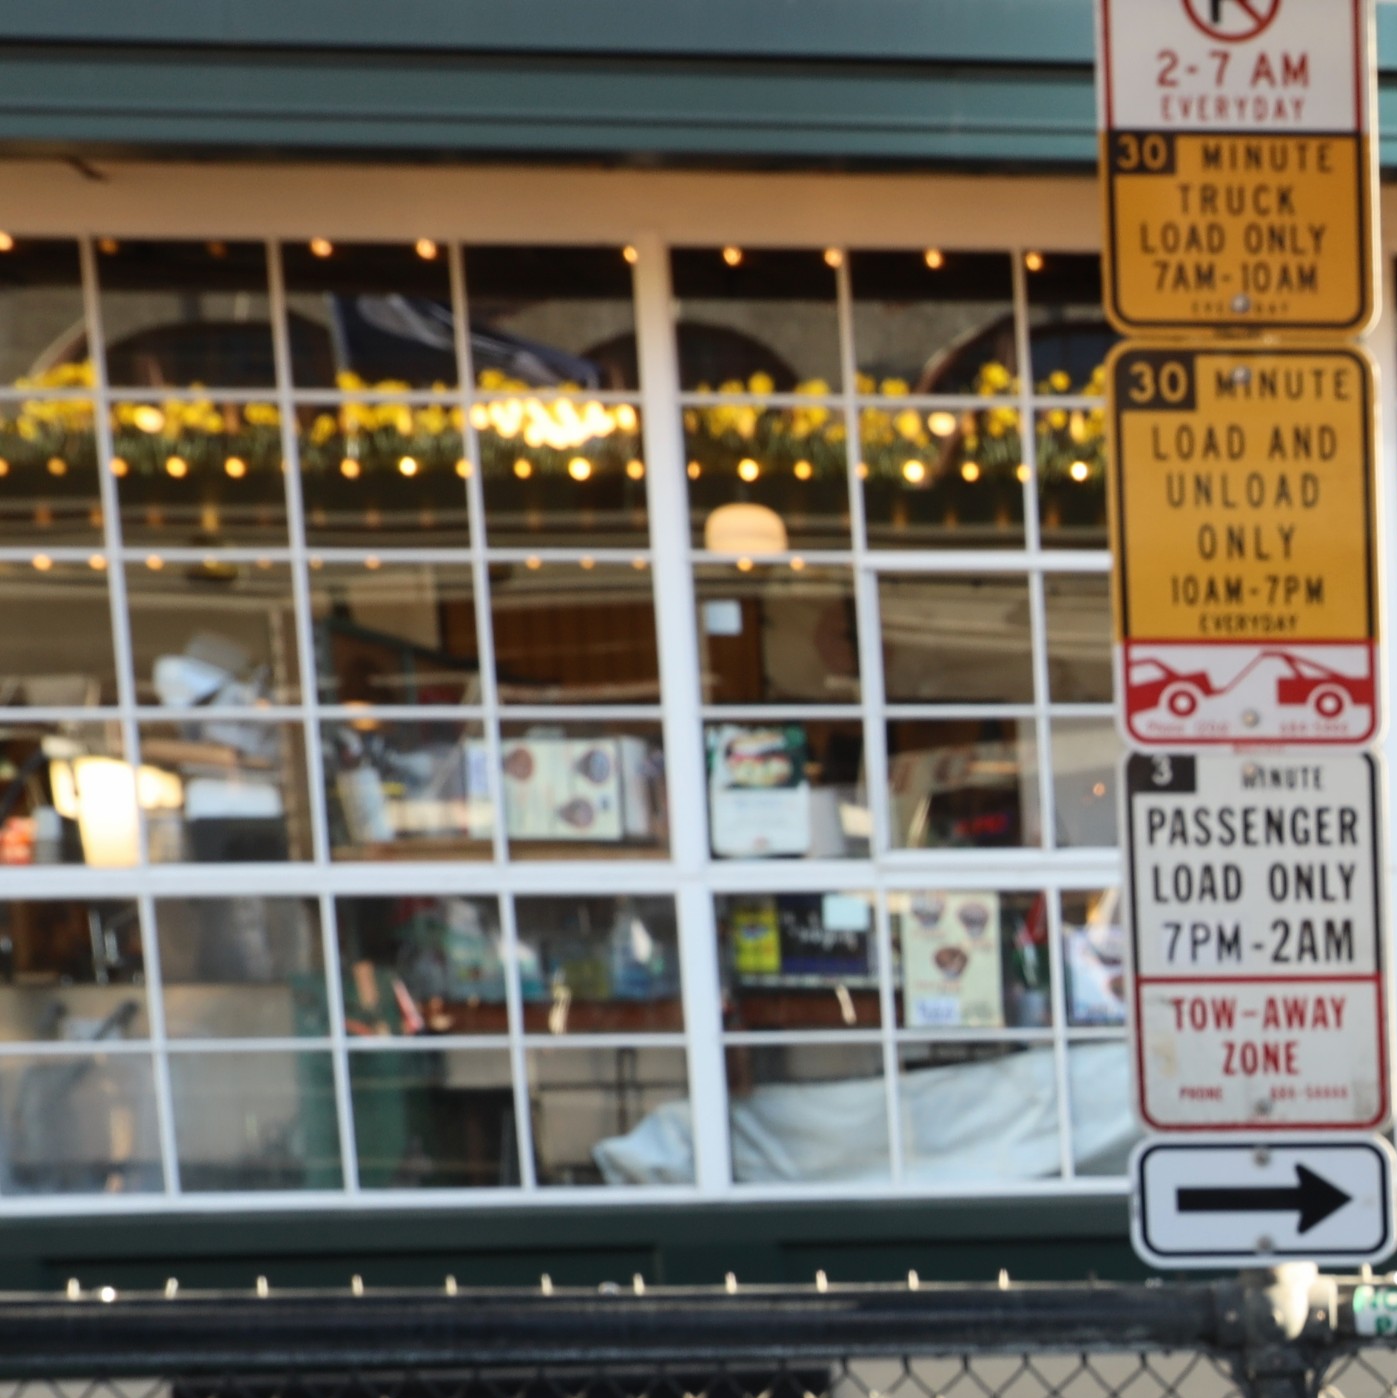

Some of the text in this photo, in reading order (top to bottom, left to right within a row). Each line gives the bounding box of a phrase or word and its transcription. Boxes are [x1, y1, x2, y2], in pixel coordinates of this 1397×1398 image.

[1157, 49, 1309, 88] 2-7 AM
[1161, 95, 1305, 121] EVERYDAY
[1115, 133, 1333, 173] 30 MINUTE
[1178, 183, 1295, 216] TRUCK
[1140, 221, 1326, 256] LOAD ONLY
[1153, 260, 1318, 295] 7AM-10AM
[1128, 360, 1188, 404] 30
[1151, 423, 1337, 462] LOAD AND
[1165, 472, 1320, 509] UNLOAD
[1198, 523, 1296, 561] ONLY
[1170, 574, 1325, 607] 10AM-7PM
[1200, 613, 1298, 633] EVERYDAY
[1148, 807, 1358, 846] PASSENGER
[1153, 862, 1355, 903] LOAD ONLY
[1163, 919, 1354, 964] 7PM-2AM
[1172, 996, 1347, 1031] TOW-AWAY
[1222, 1041, 1301, 1077] ZONE
